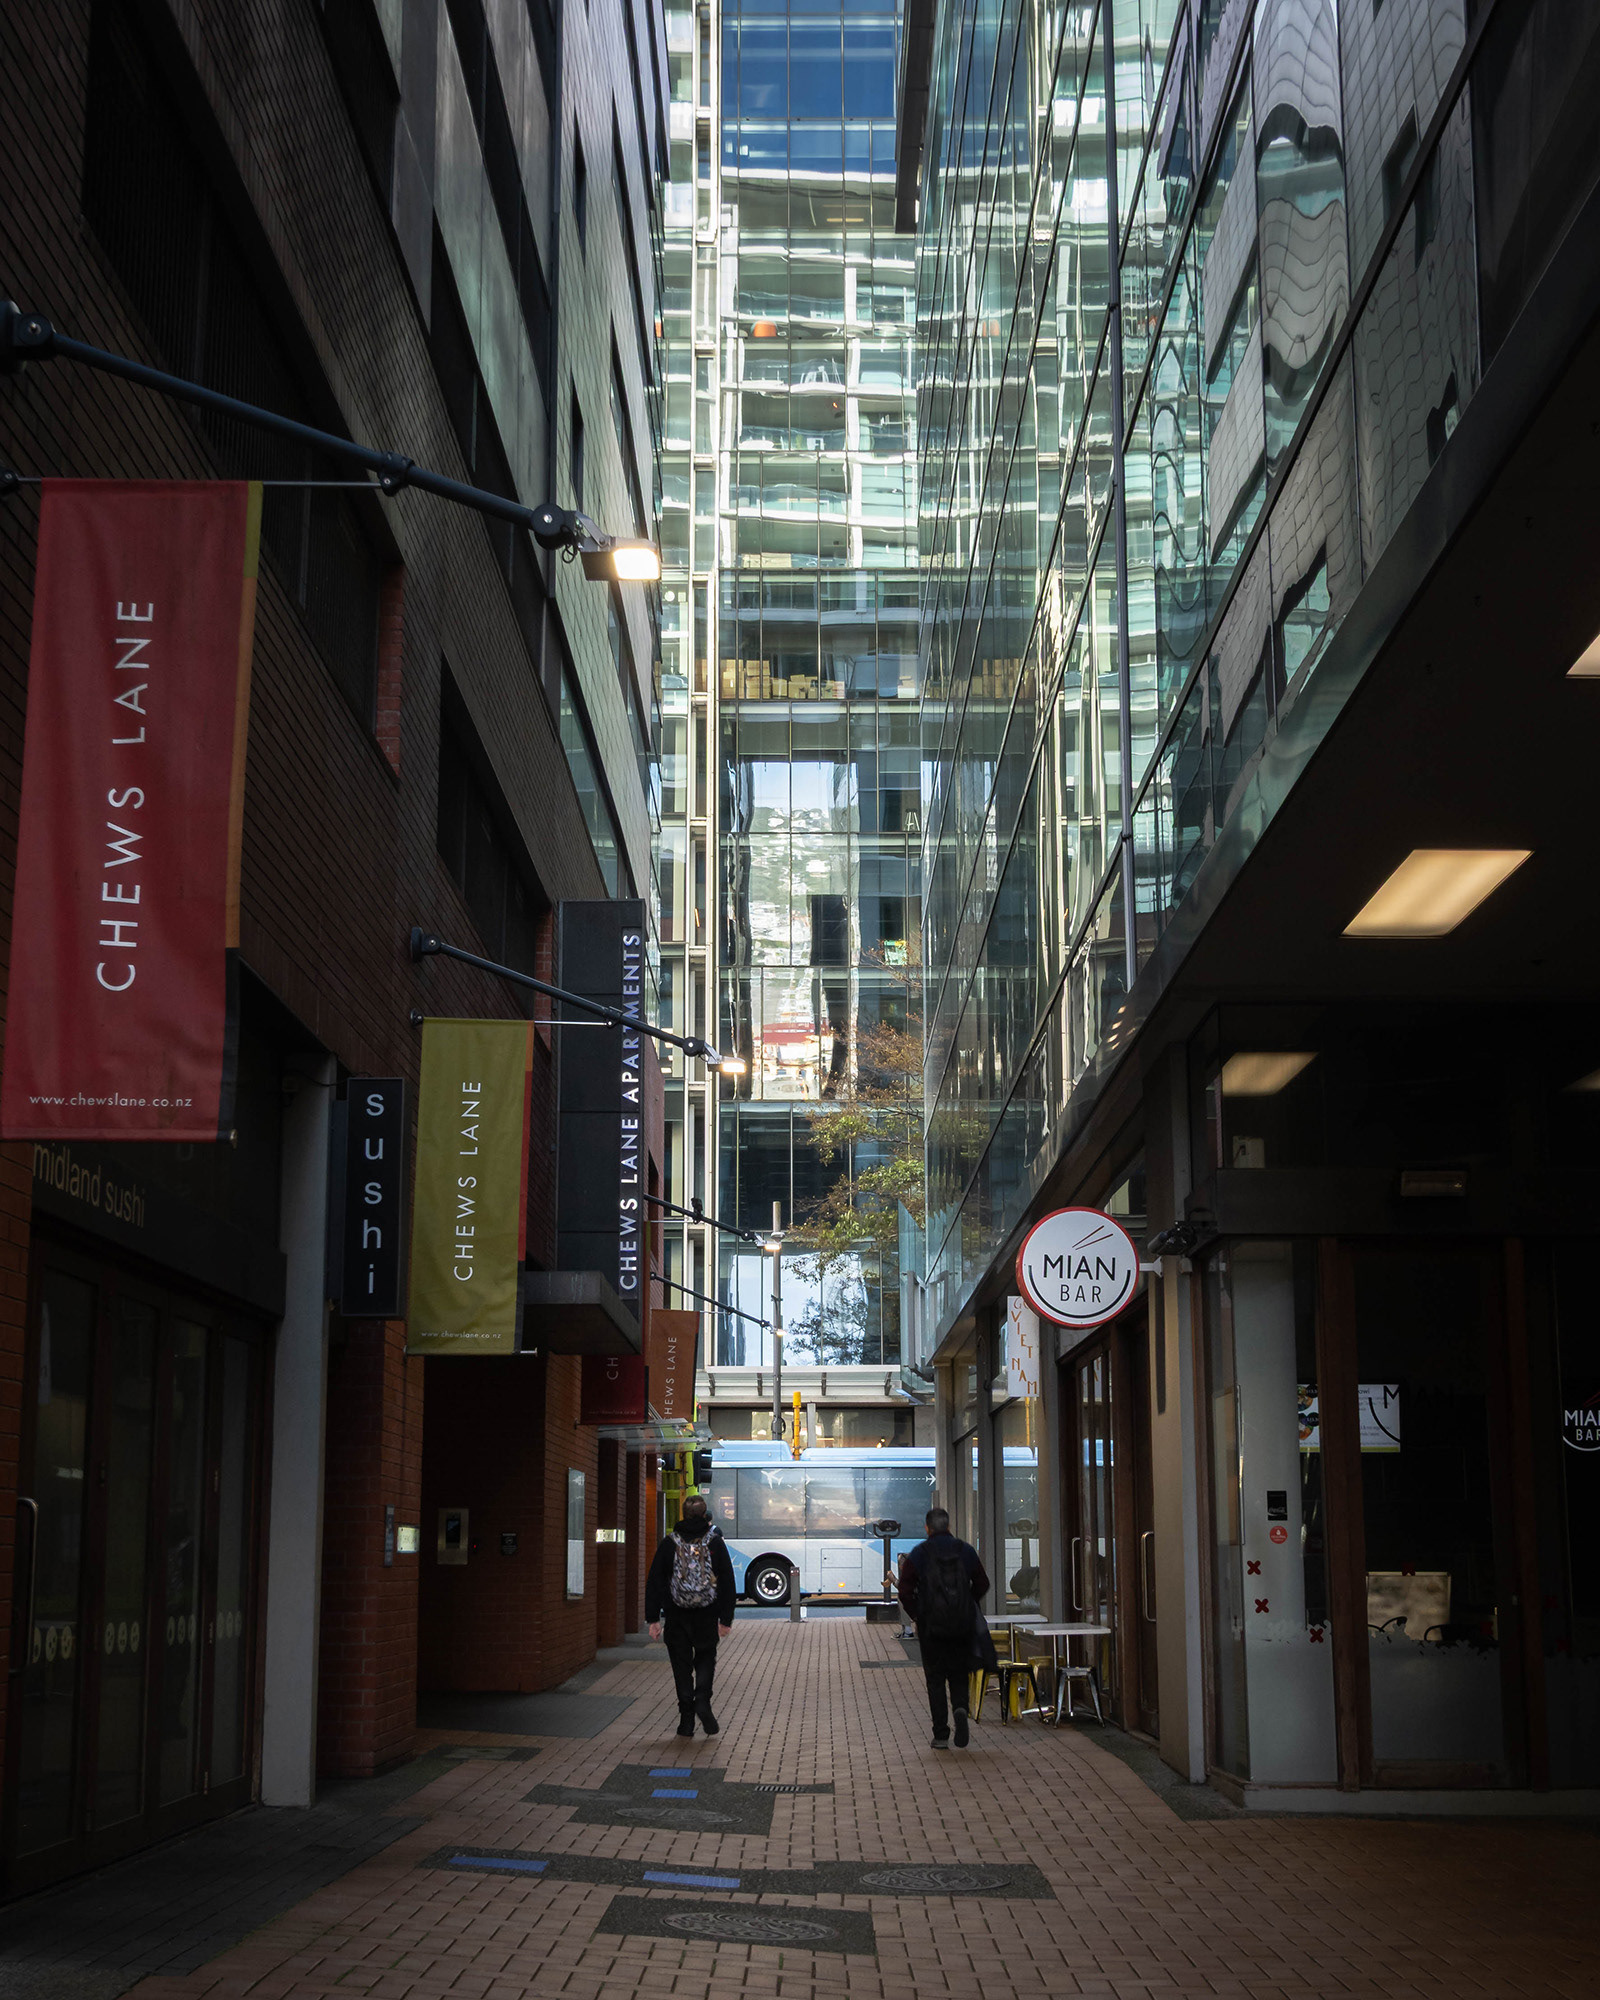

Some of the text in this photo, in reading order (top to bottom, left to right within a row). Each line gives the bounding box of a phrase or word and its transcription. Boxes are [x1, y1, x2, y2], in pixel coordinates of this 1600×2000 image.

[96, 601, 155, 992] CHEWS LANE
[29, 1092, 193, 1108] www.chewslane.co.nz
[32, 1142, 146, 1228] midland sushi
[361, 1093, 385, 1294] sushi
[453, 1081, 482, 1281] CHEWS LANE
[620, 1118, 639, 1185] LANE
[619, 1197, 639, 1291] CHEWS
[1042, 1254, 1116, 1281] MIAN
[1060, 1284, 1101, 1303] BAR
[663, 1336, 677, 1420] HEWS LANE
[1564, 1409, 1600, 1427] MIA
